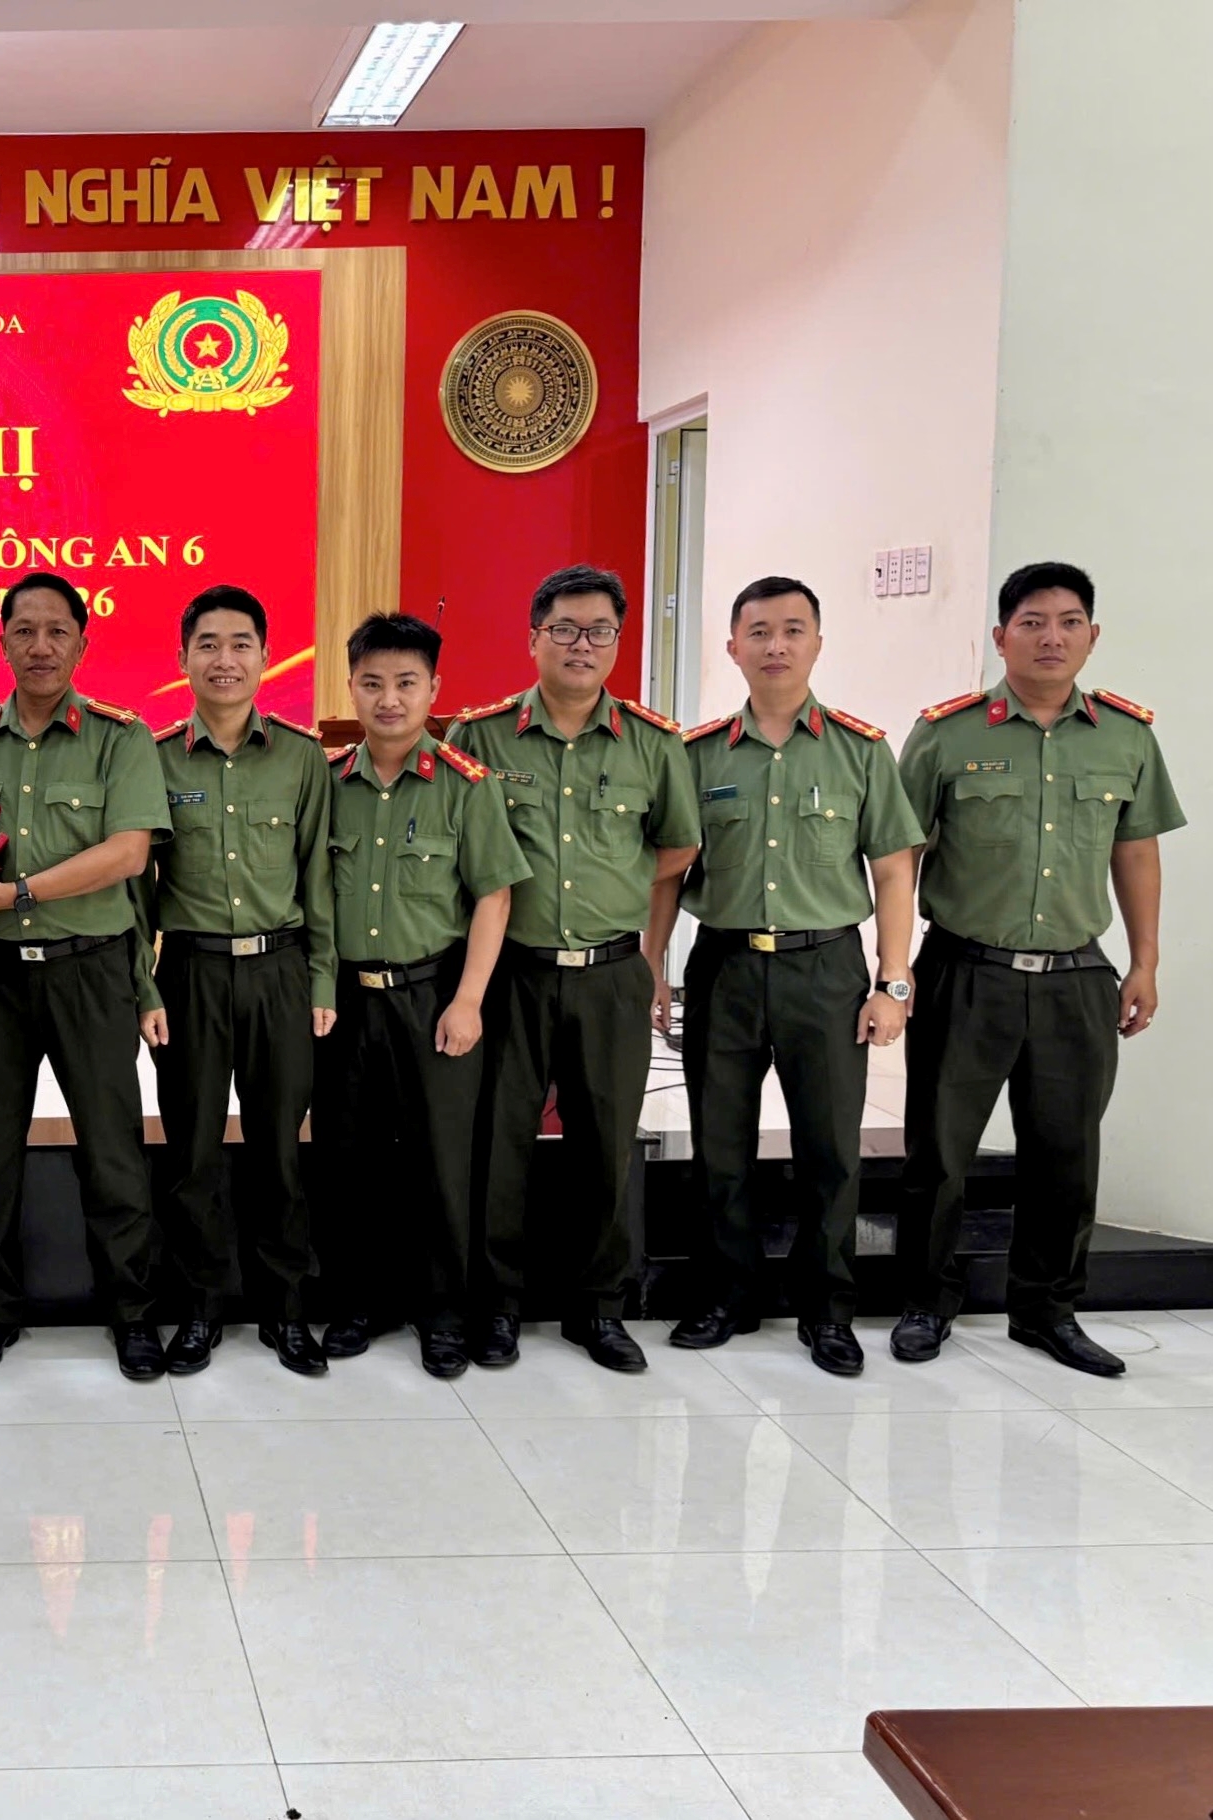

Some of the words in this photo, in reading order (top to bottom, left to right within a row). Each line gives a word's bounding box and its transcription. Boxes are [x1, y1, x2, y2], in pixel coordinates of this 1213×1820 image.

[25, 157, 219, 225] NGHĨA
[244, 155, 382, 232] VIỆT
[411, 165, 577, 220] NAM
[105, 536, 170, 566] AN
[182, 535, 205, 566] 6
